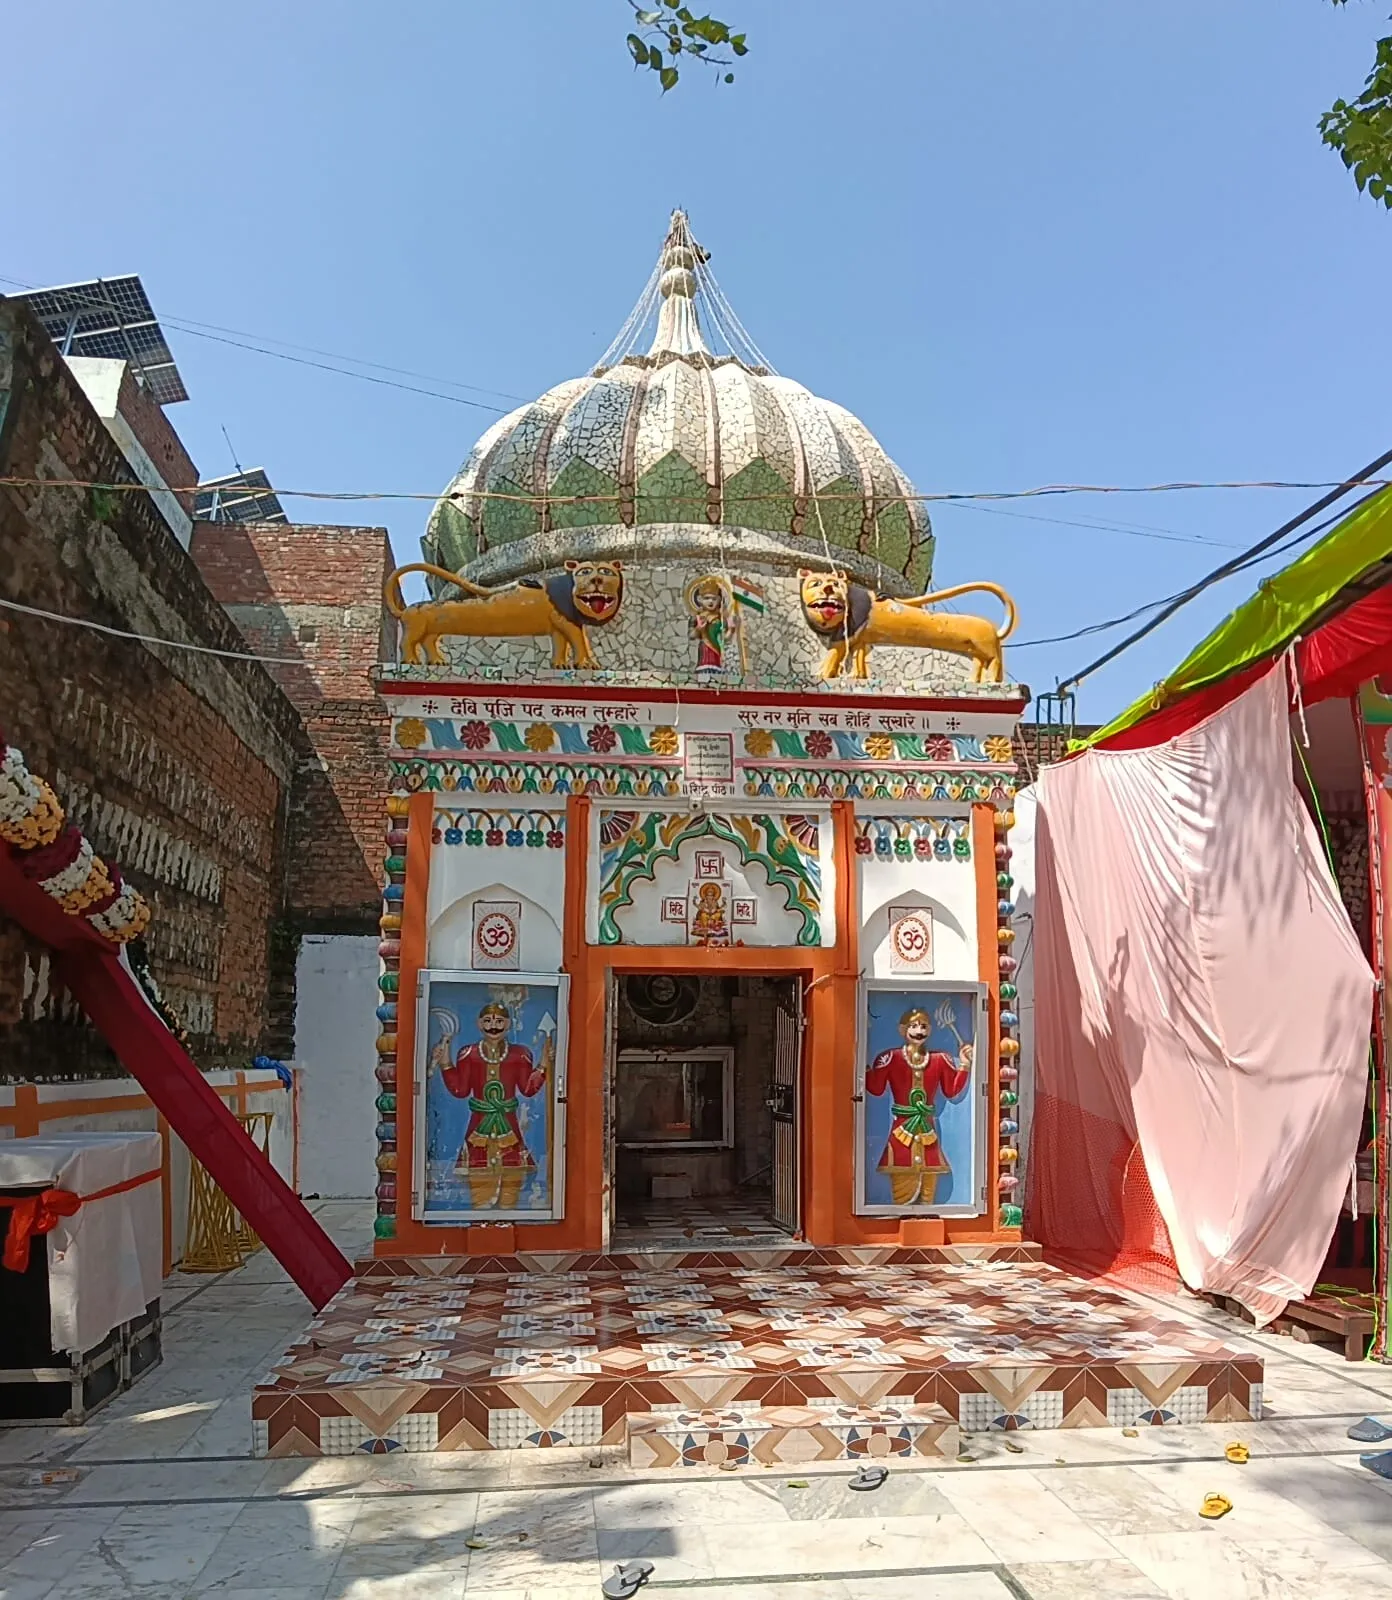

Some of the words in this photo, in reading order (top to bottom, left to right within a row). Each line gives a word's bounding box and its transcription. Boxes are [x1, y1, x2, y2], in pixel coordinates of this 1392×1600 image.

[483, 699, 516, 719] पूजि
[521, 704, 546, 719] पद
[550, 705, 587, 719] कमल
[592, 703, 639, 723] तुम्हारे
[737, 711, 760, 727] सुर
[763, 711, 782, 726] नर
[786, 709, 811, 729] मुनि
